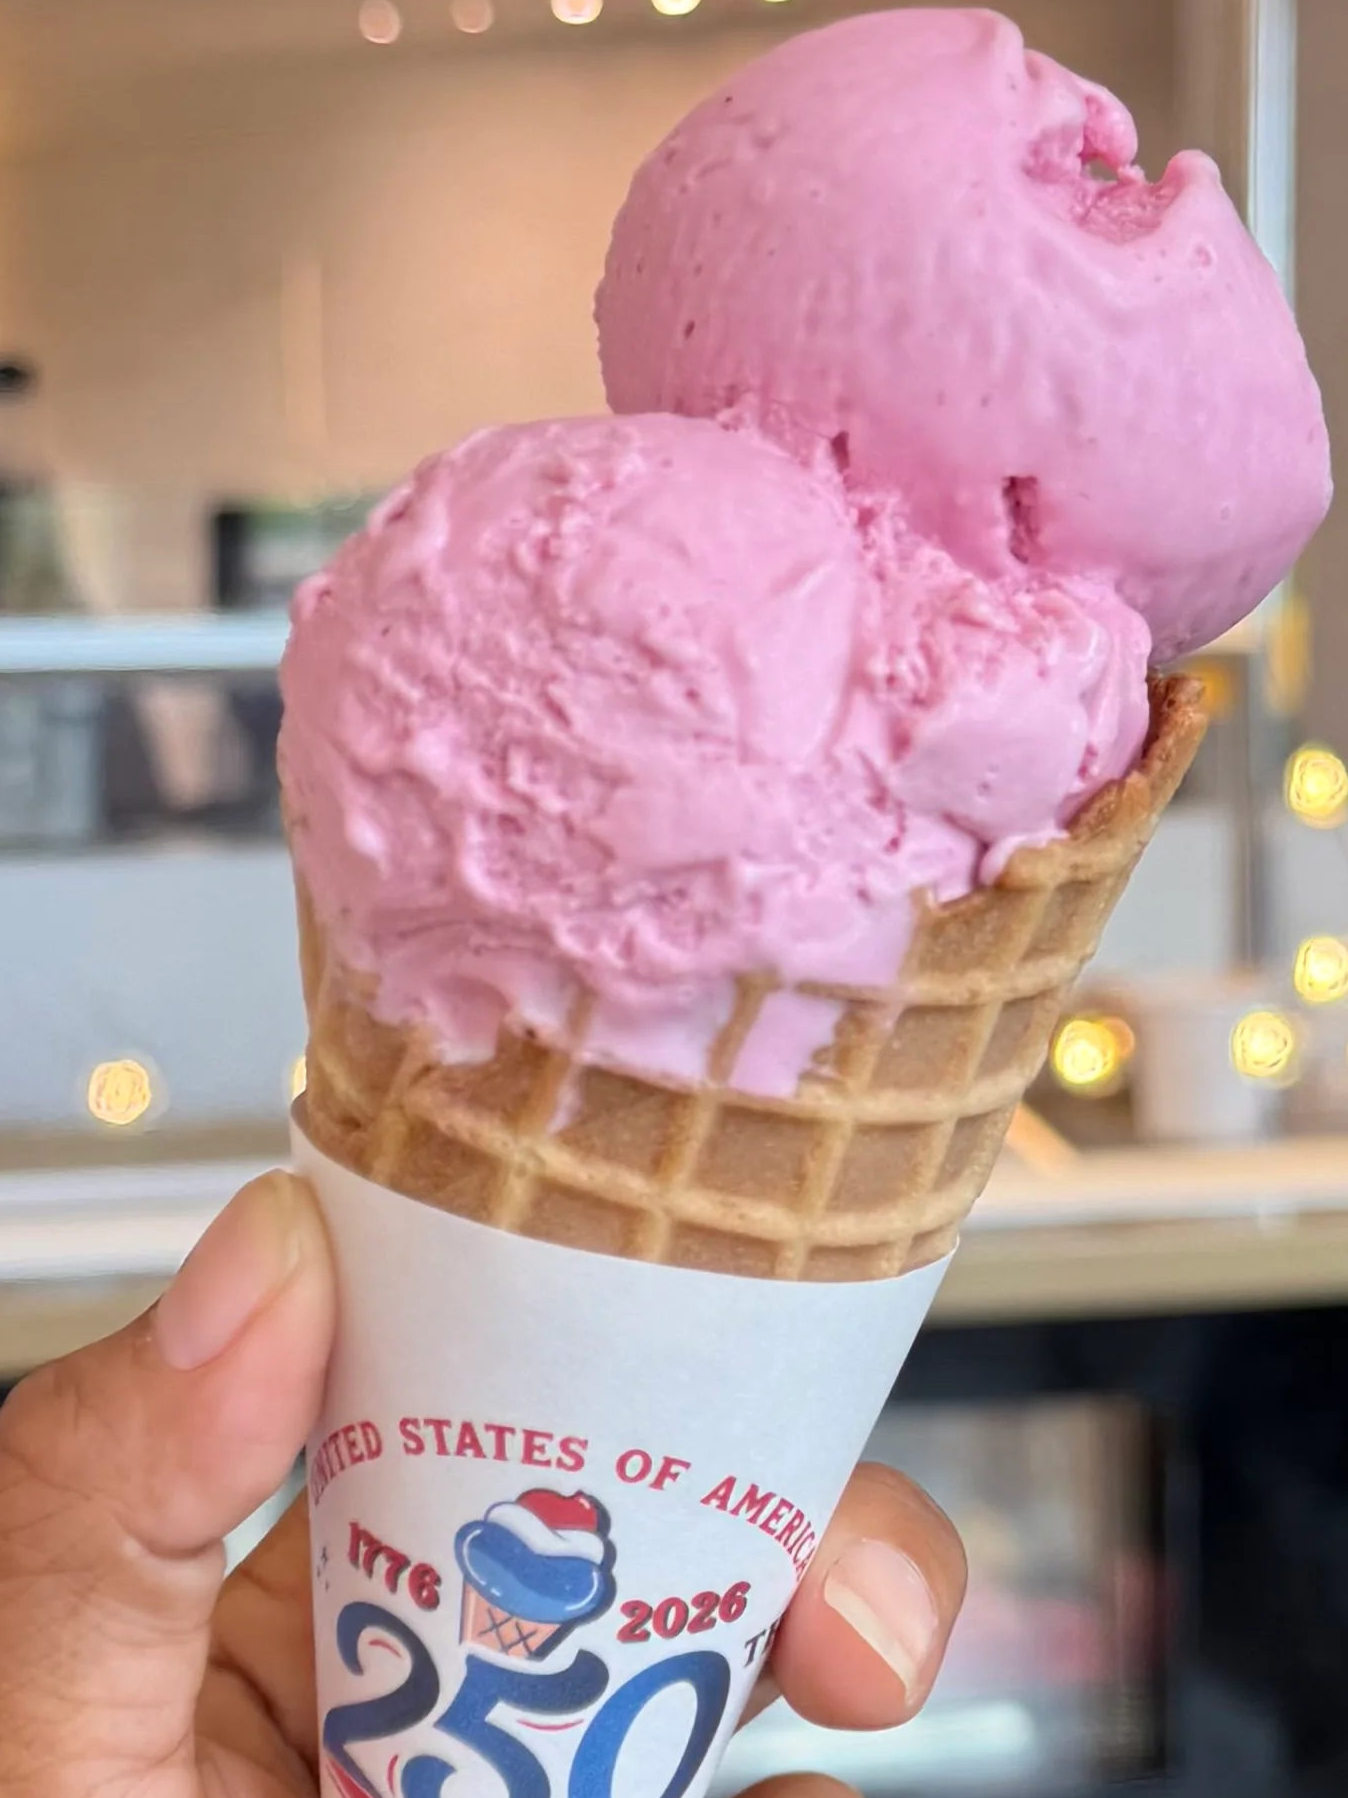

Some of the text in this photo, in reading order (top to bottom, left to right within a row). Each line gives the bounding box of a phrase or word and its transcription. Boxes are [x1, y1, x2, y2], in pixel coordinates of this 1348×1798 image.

[398, 1417, 589, 1473] STATES
[615, 1448, 692, 1491] OF
[347, 1520, 442, 1611] 1776
[615, 1580, 751, 1644] 2026
